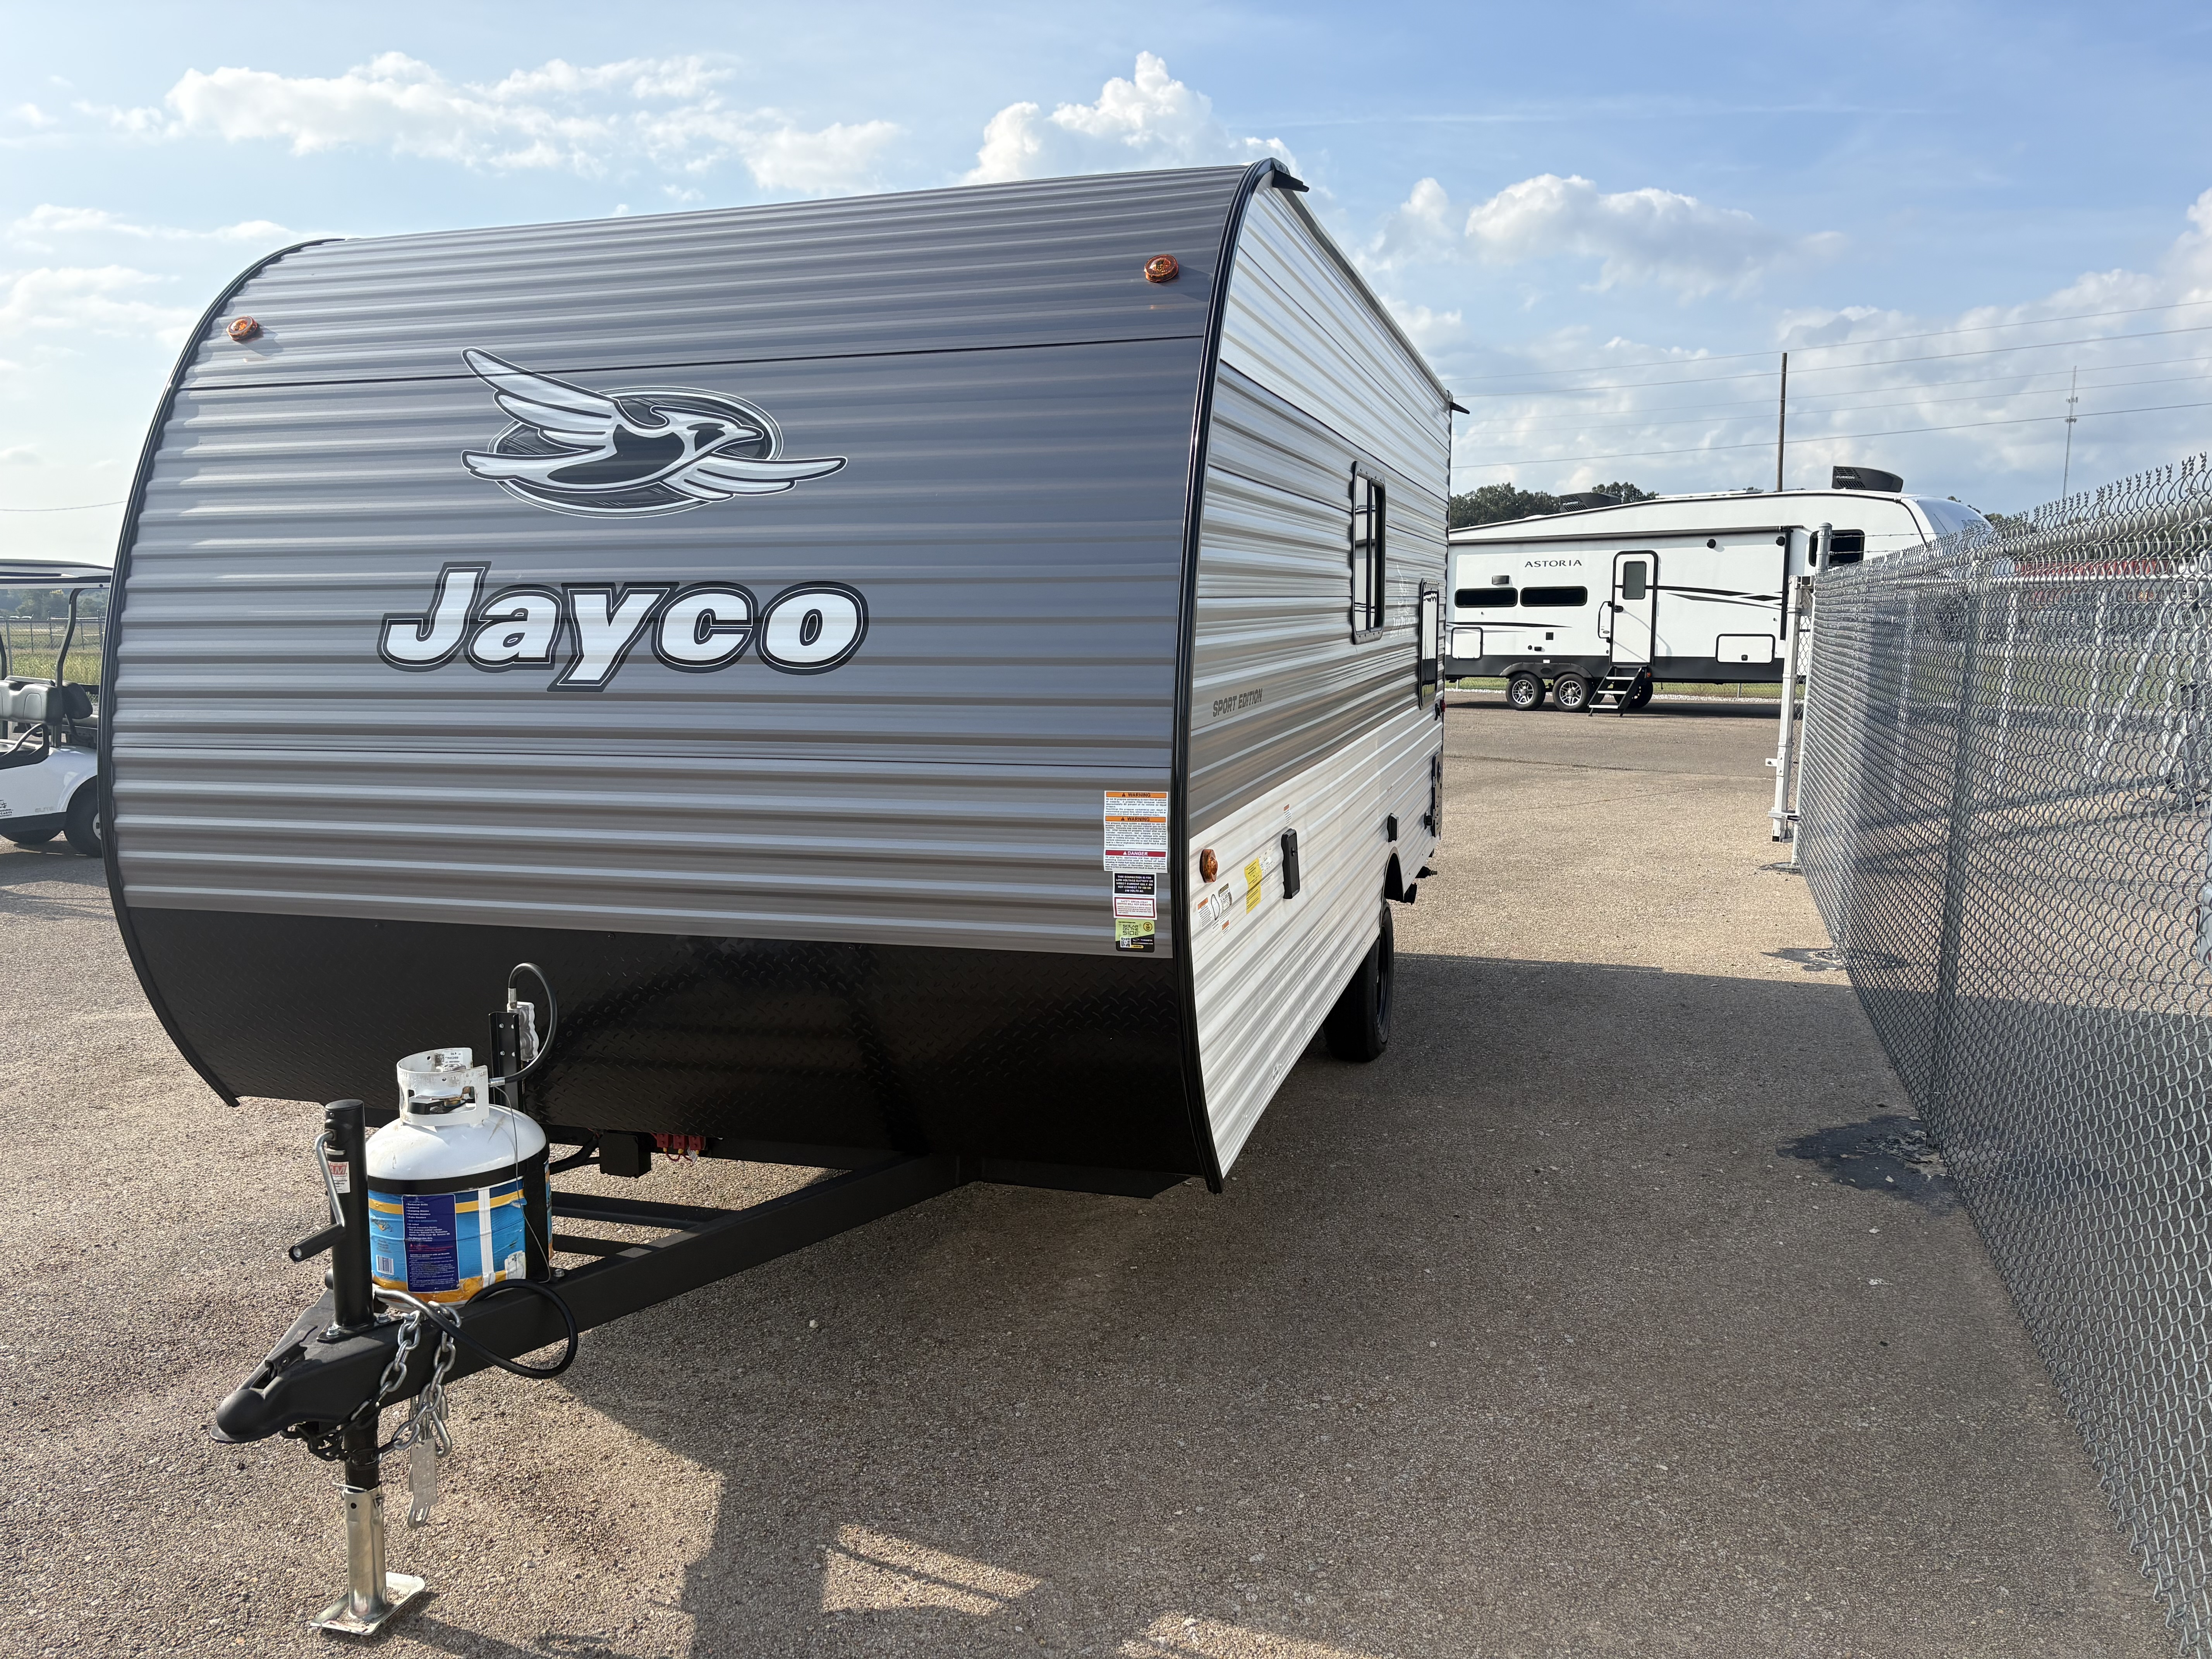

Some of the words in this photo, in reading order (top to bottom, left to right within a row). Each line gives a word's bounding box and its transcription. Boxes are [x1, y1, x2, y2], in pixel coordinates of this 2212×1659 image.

[1525, 560, 1582, 568] ASTORIA
[376, 560, 869, 692] Jayco
[1213, 695, 1237, 717] SPORT
[1238, 688, 1262, 709] EDITION
